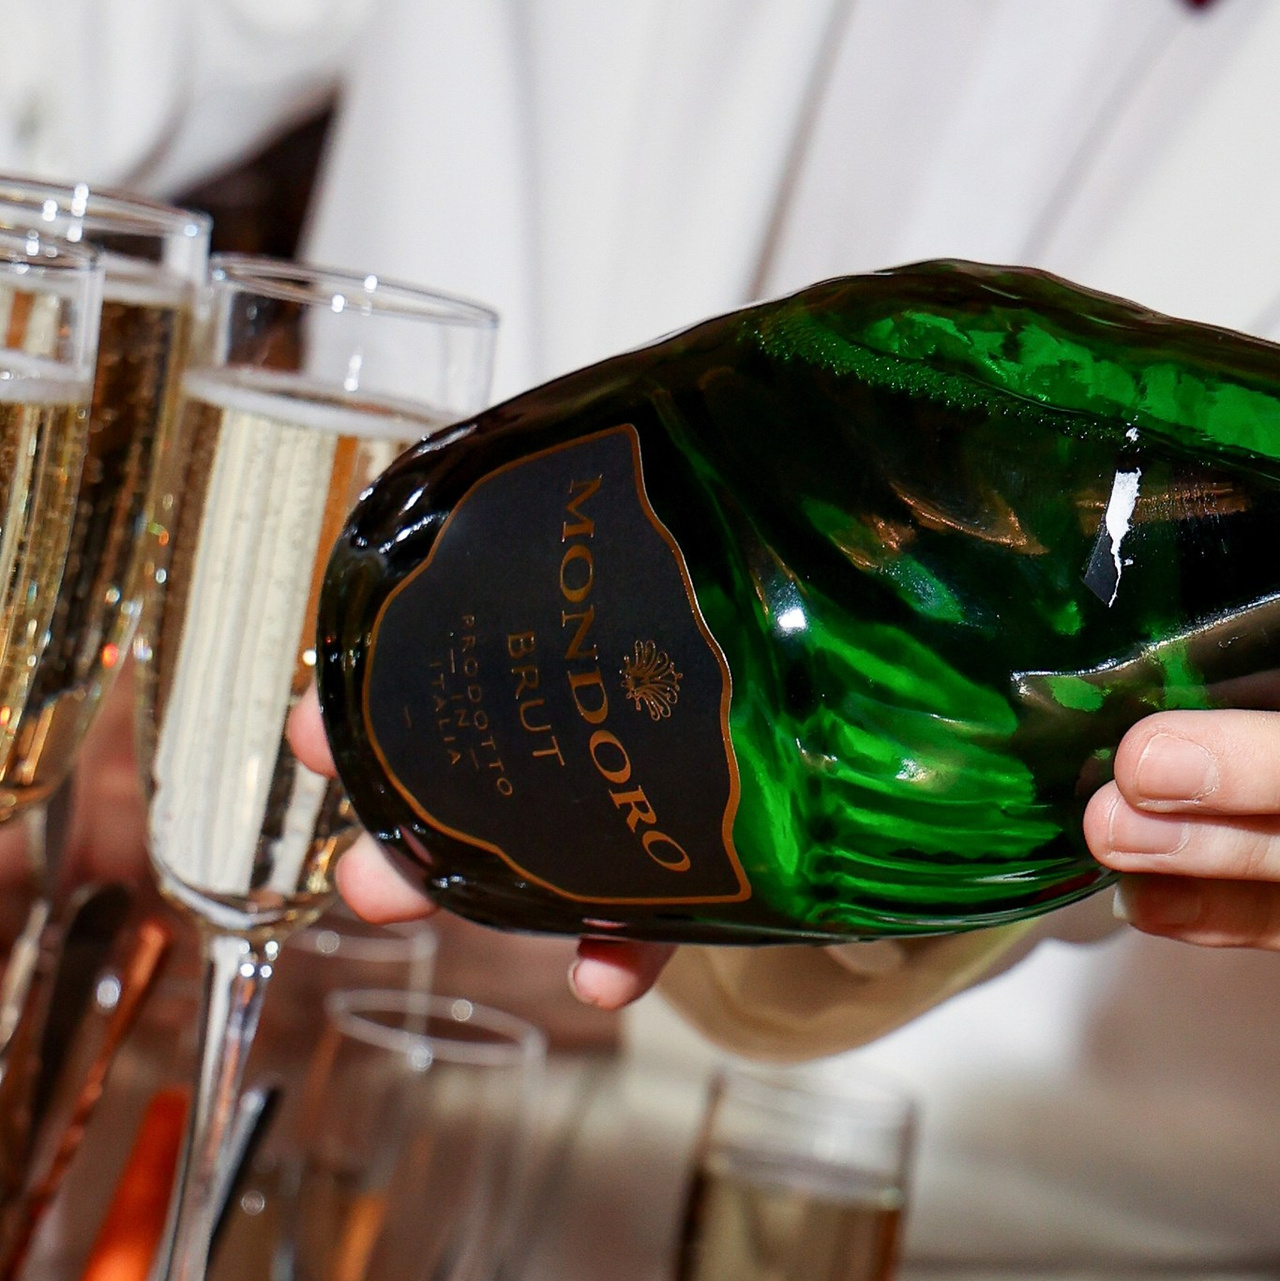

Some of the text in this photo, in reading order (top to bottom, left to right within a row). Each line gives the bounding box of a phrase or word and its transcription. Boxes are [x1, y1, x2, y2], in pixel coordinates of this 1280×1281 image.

[429, 659, 462, 766] ITALIA
[451, 693, 473, 728] IN
[461, 613, 514, 797] PRODOTTO
[507, 630, 566, 767] BRUT
[558, 472, 692, 873] MONDORO
